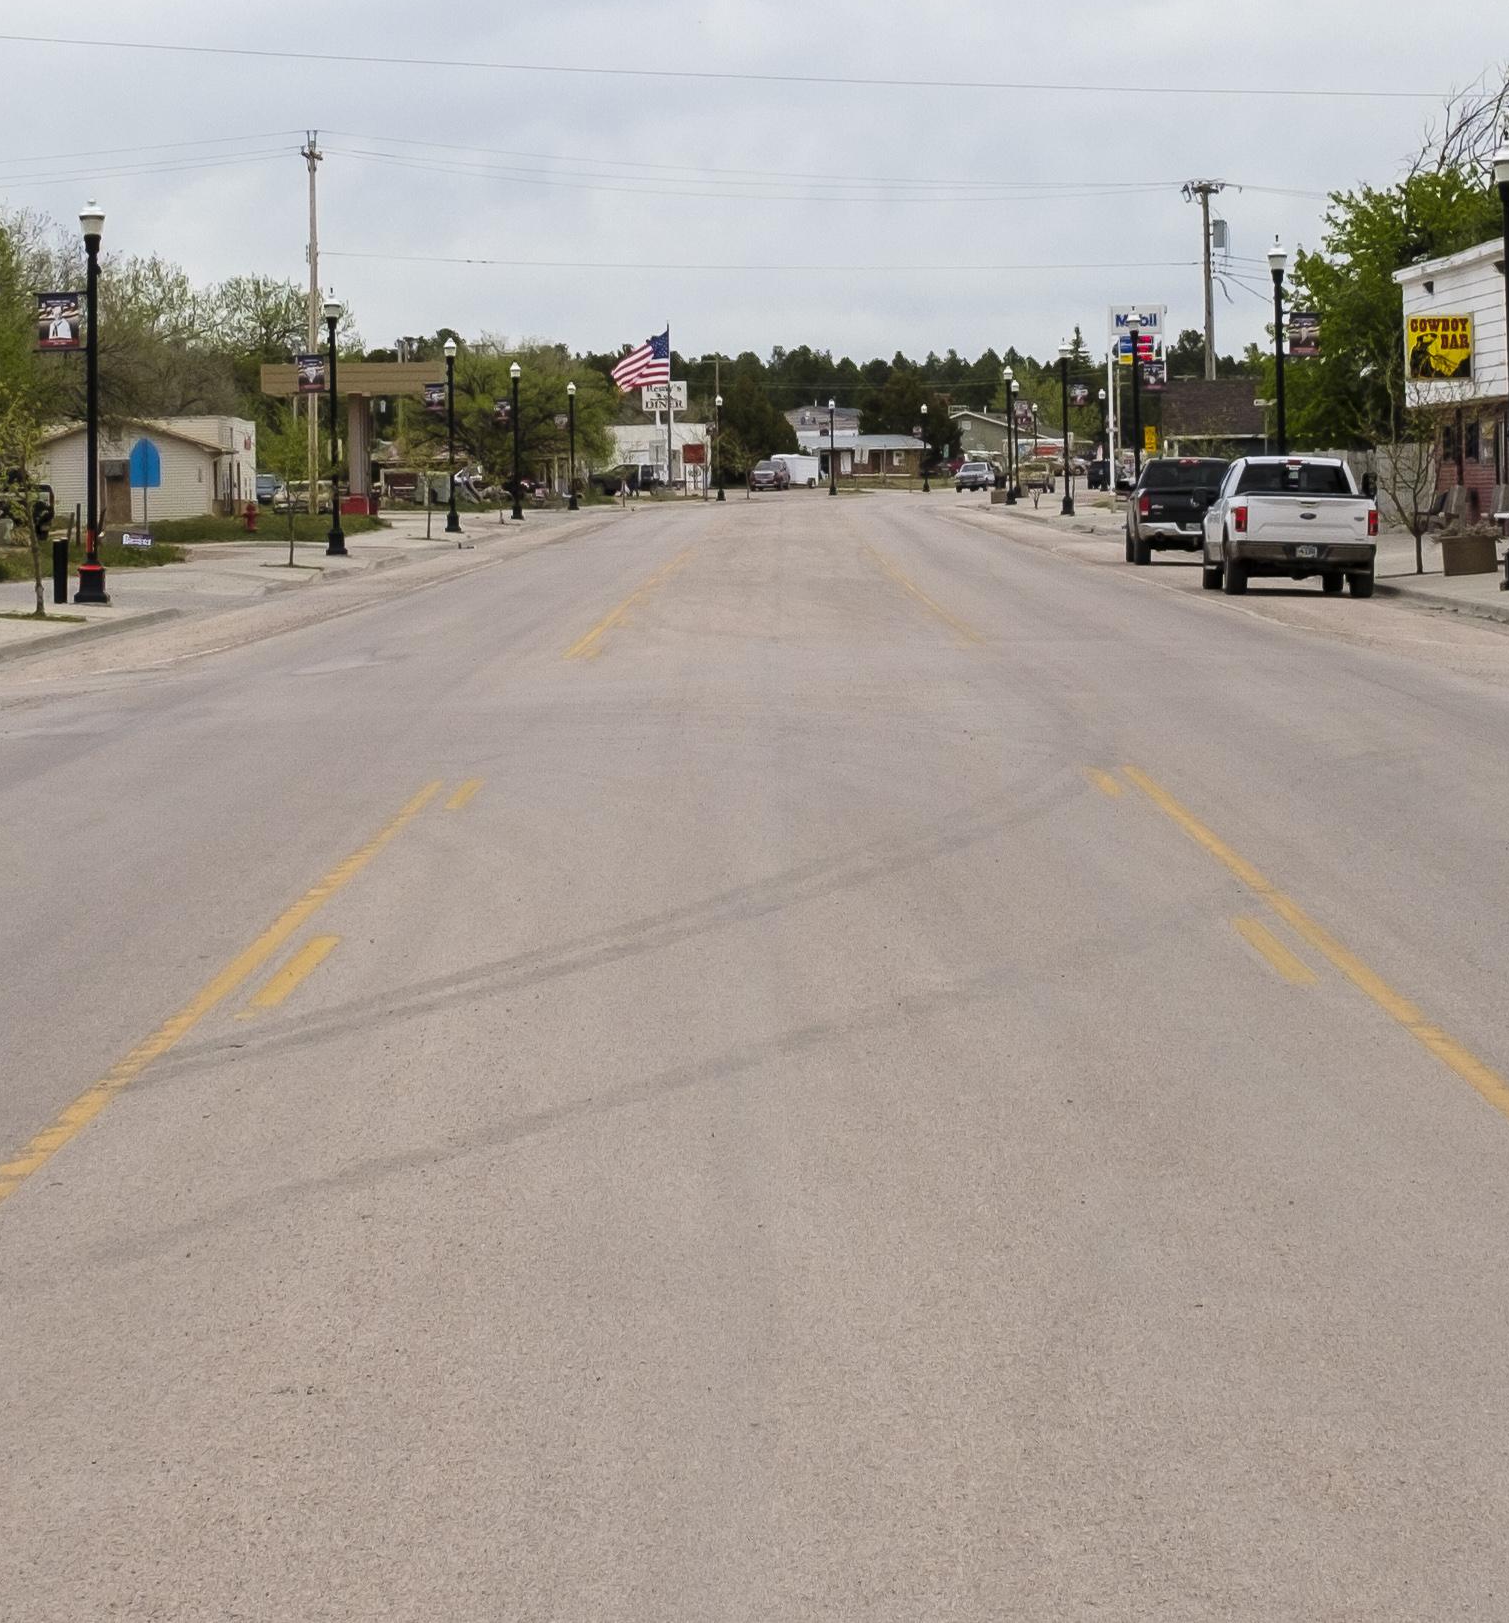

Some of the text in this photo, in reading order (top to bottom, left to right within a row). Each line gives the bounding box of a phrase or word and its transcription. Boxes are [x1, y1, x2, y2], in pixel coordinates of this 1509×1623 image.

[1115, 313, 1157, 327] Mbil
[1410, 318, 1469, 332] COWBOY
[1440, 333, 1470, 350] BAR
[645, 400, 684, 408] DINER
